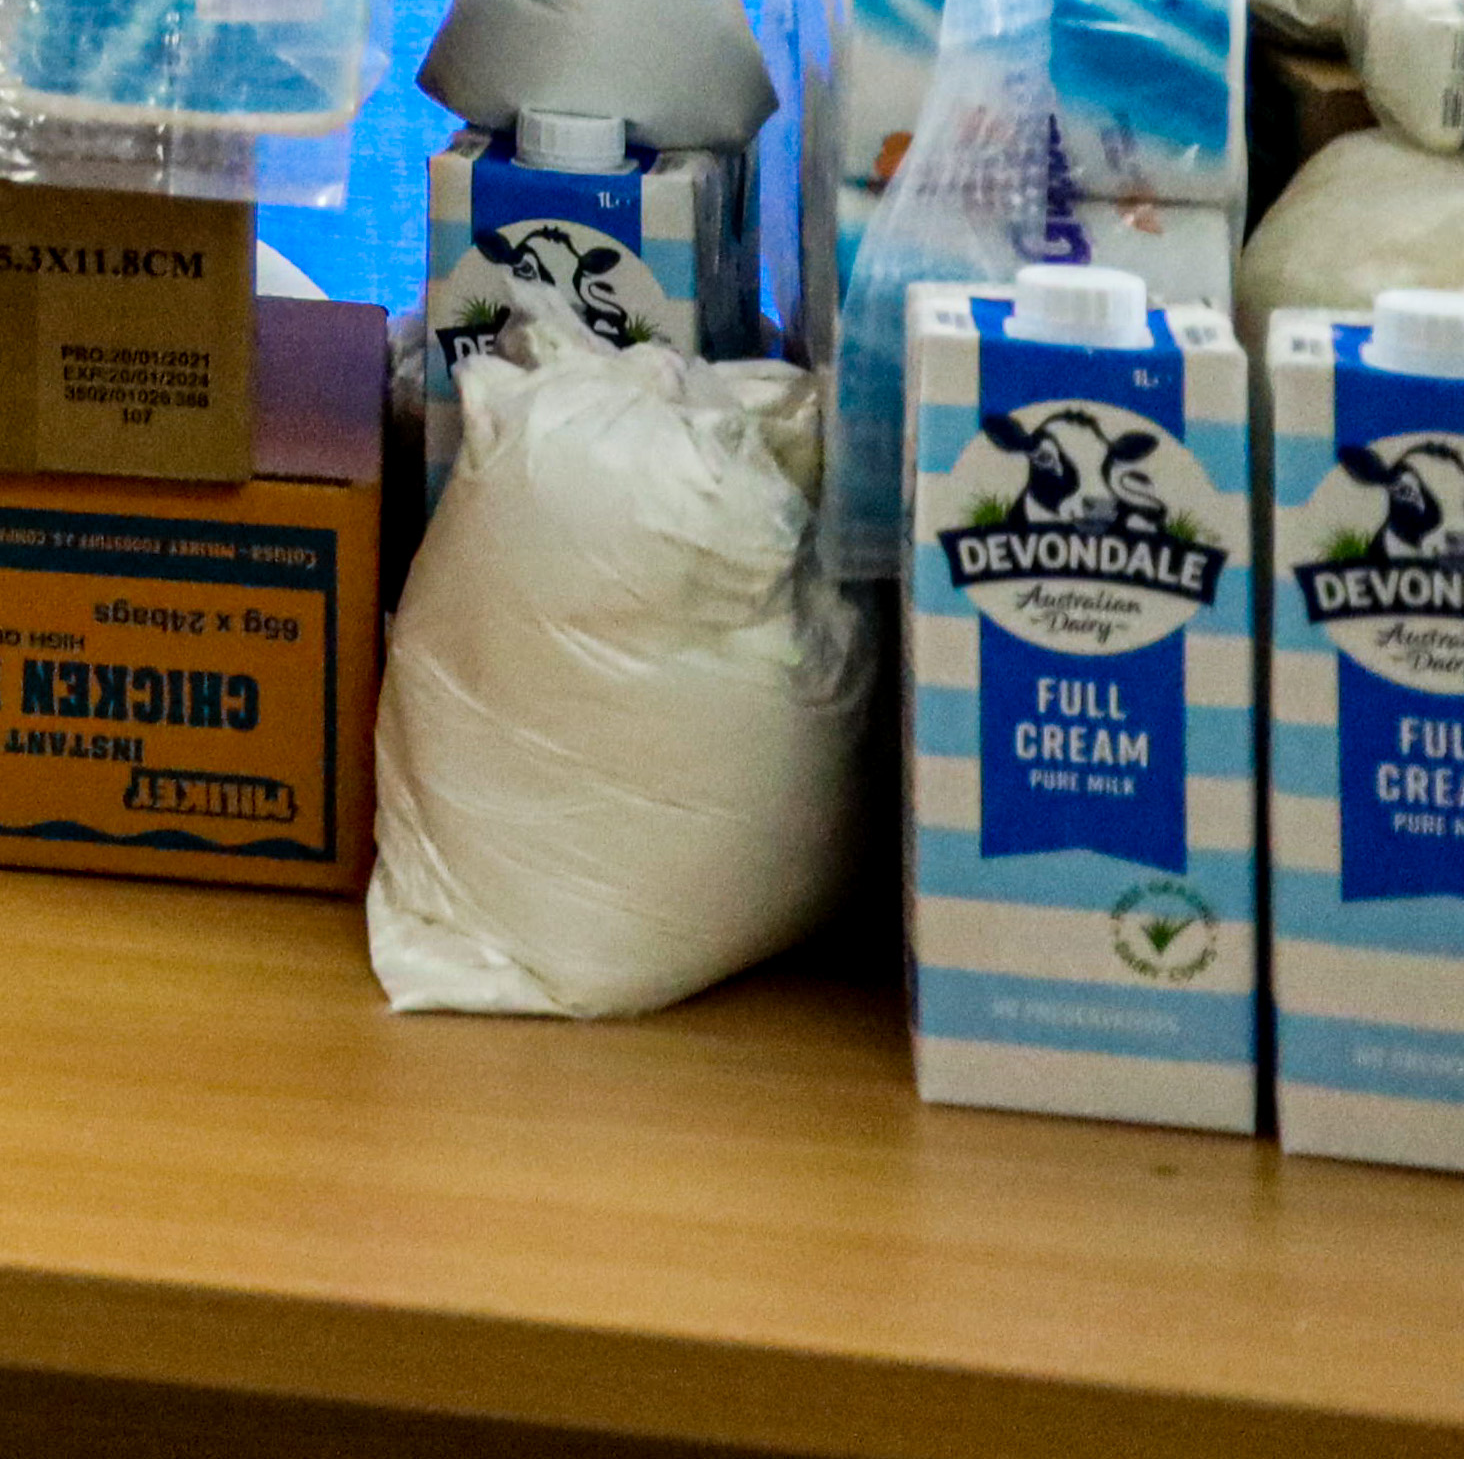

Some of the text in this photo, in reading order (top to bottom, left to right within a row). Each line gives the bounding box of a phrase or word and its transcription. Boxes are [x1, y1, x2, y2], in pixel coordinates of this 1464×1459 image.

[958, 532, 1208, 591] DEVONDALE
[1016, 582, 1143, 615] Australian
[1315, 567, 1464, 612] DEVON
[94, 598, 299, 642] 65g x 24bags
[1048, 611, 1115, 644] Dairy
[28, 633, 86, 652] HIGH
[21, 659, 260, 732] CHICKEN
[1036, 677, 1127, 721] FULL
[4, 726, 145, 763] INSTANT
[1015, 722, 1149, 768] CREAM
[132, 776, 292, 821] MILIKET
[1029, 768, 1136, 796] PURE MILK
[1393, 812, 1447, 835] PURE
